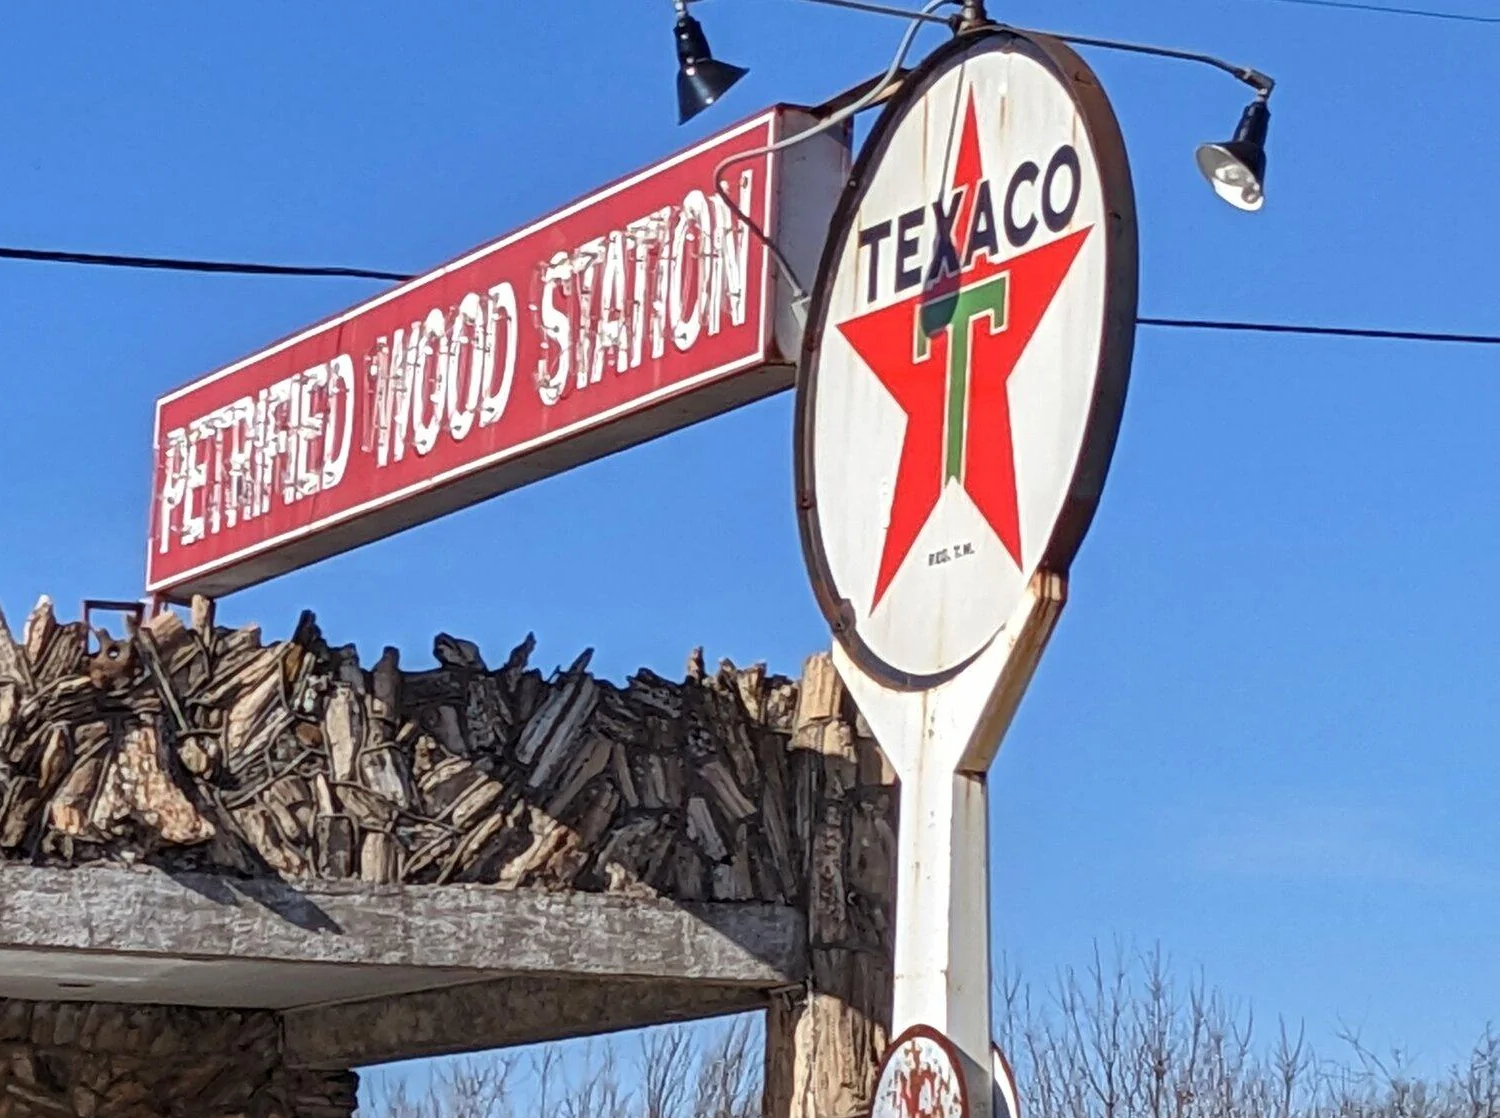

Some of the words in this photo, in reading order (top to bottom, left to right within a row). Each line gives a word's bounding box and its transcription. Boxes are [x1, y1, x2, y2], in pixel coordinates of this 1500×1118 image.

[159, 353, 354, 554] PETRIFIED
[361, 281, 518, 468] WOOD
[532, 168, 753, 406] STATION
[857, 144, 1082, 305] TEXACO
